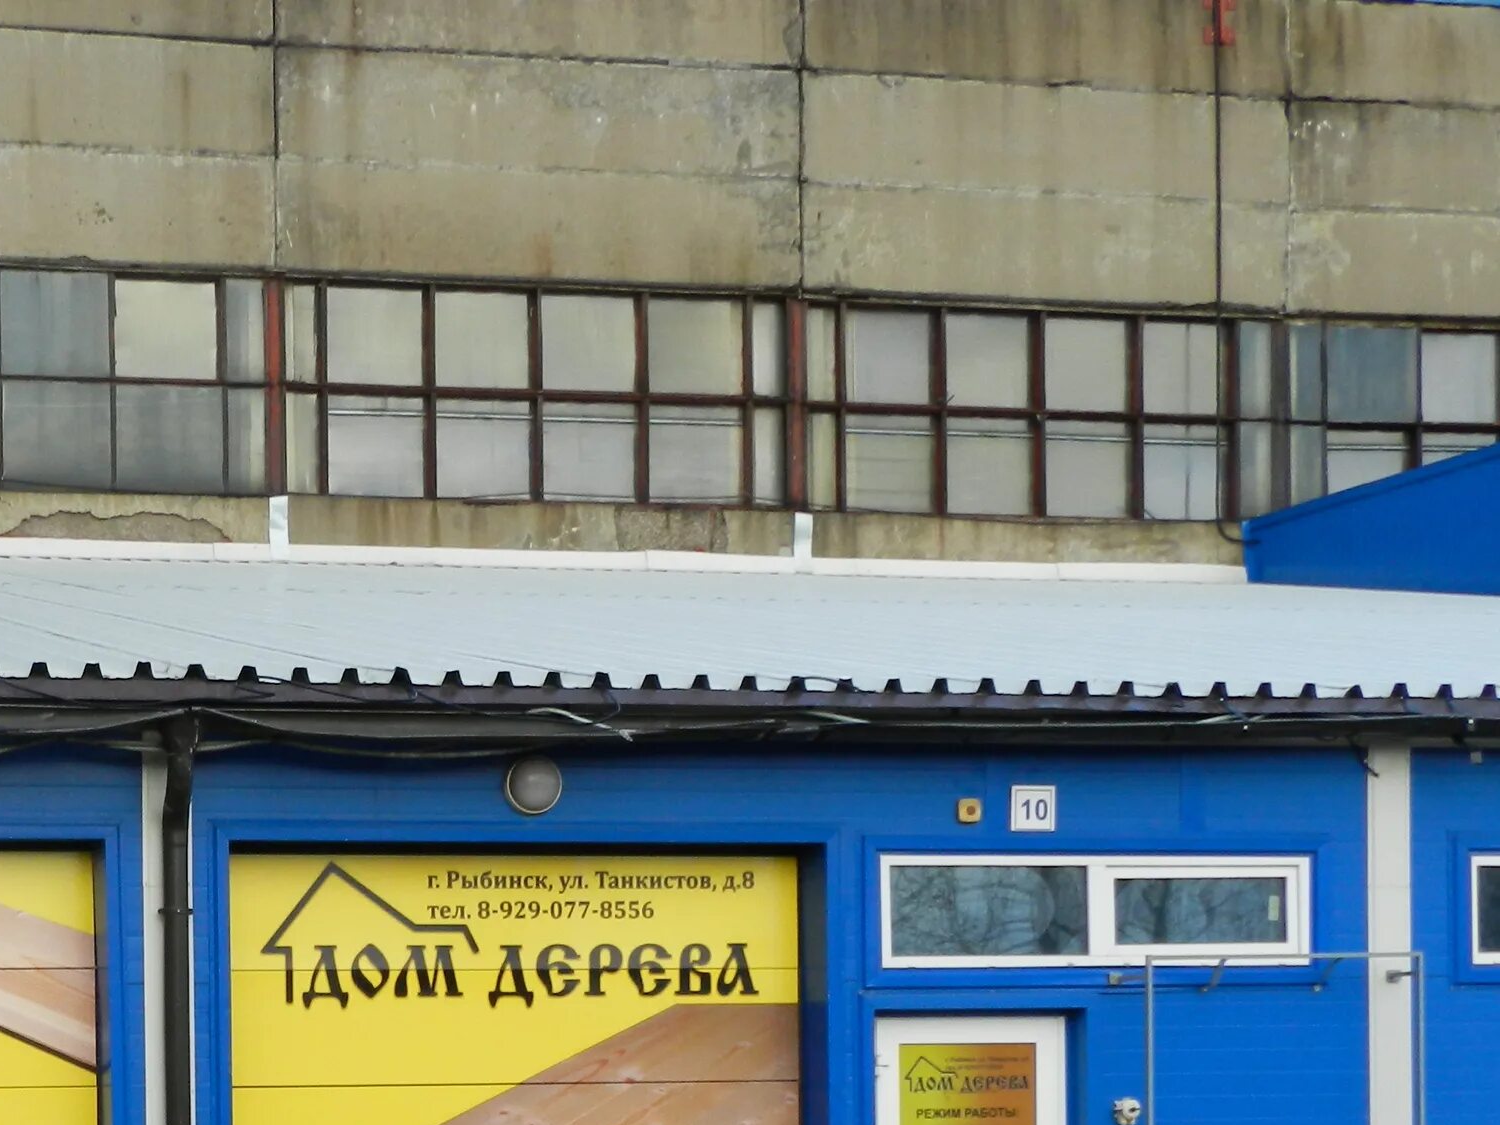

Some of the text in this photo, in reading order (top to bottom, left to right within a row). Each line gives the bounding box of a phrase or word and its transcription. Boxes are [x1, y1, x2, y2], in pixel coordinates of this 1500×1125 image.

[1021, 799, 1048, 820] 10
[427, 870, 755, 893] г. Рыбинск, ул. Танкистов, д.8
[427, 901, 654, 921] тел. 8-929-077-8556
[302, 942, 760, 1009] ДОМ ДЕРЕВА
[916, 1108, 960, 1119] РЕЖИМ
